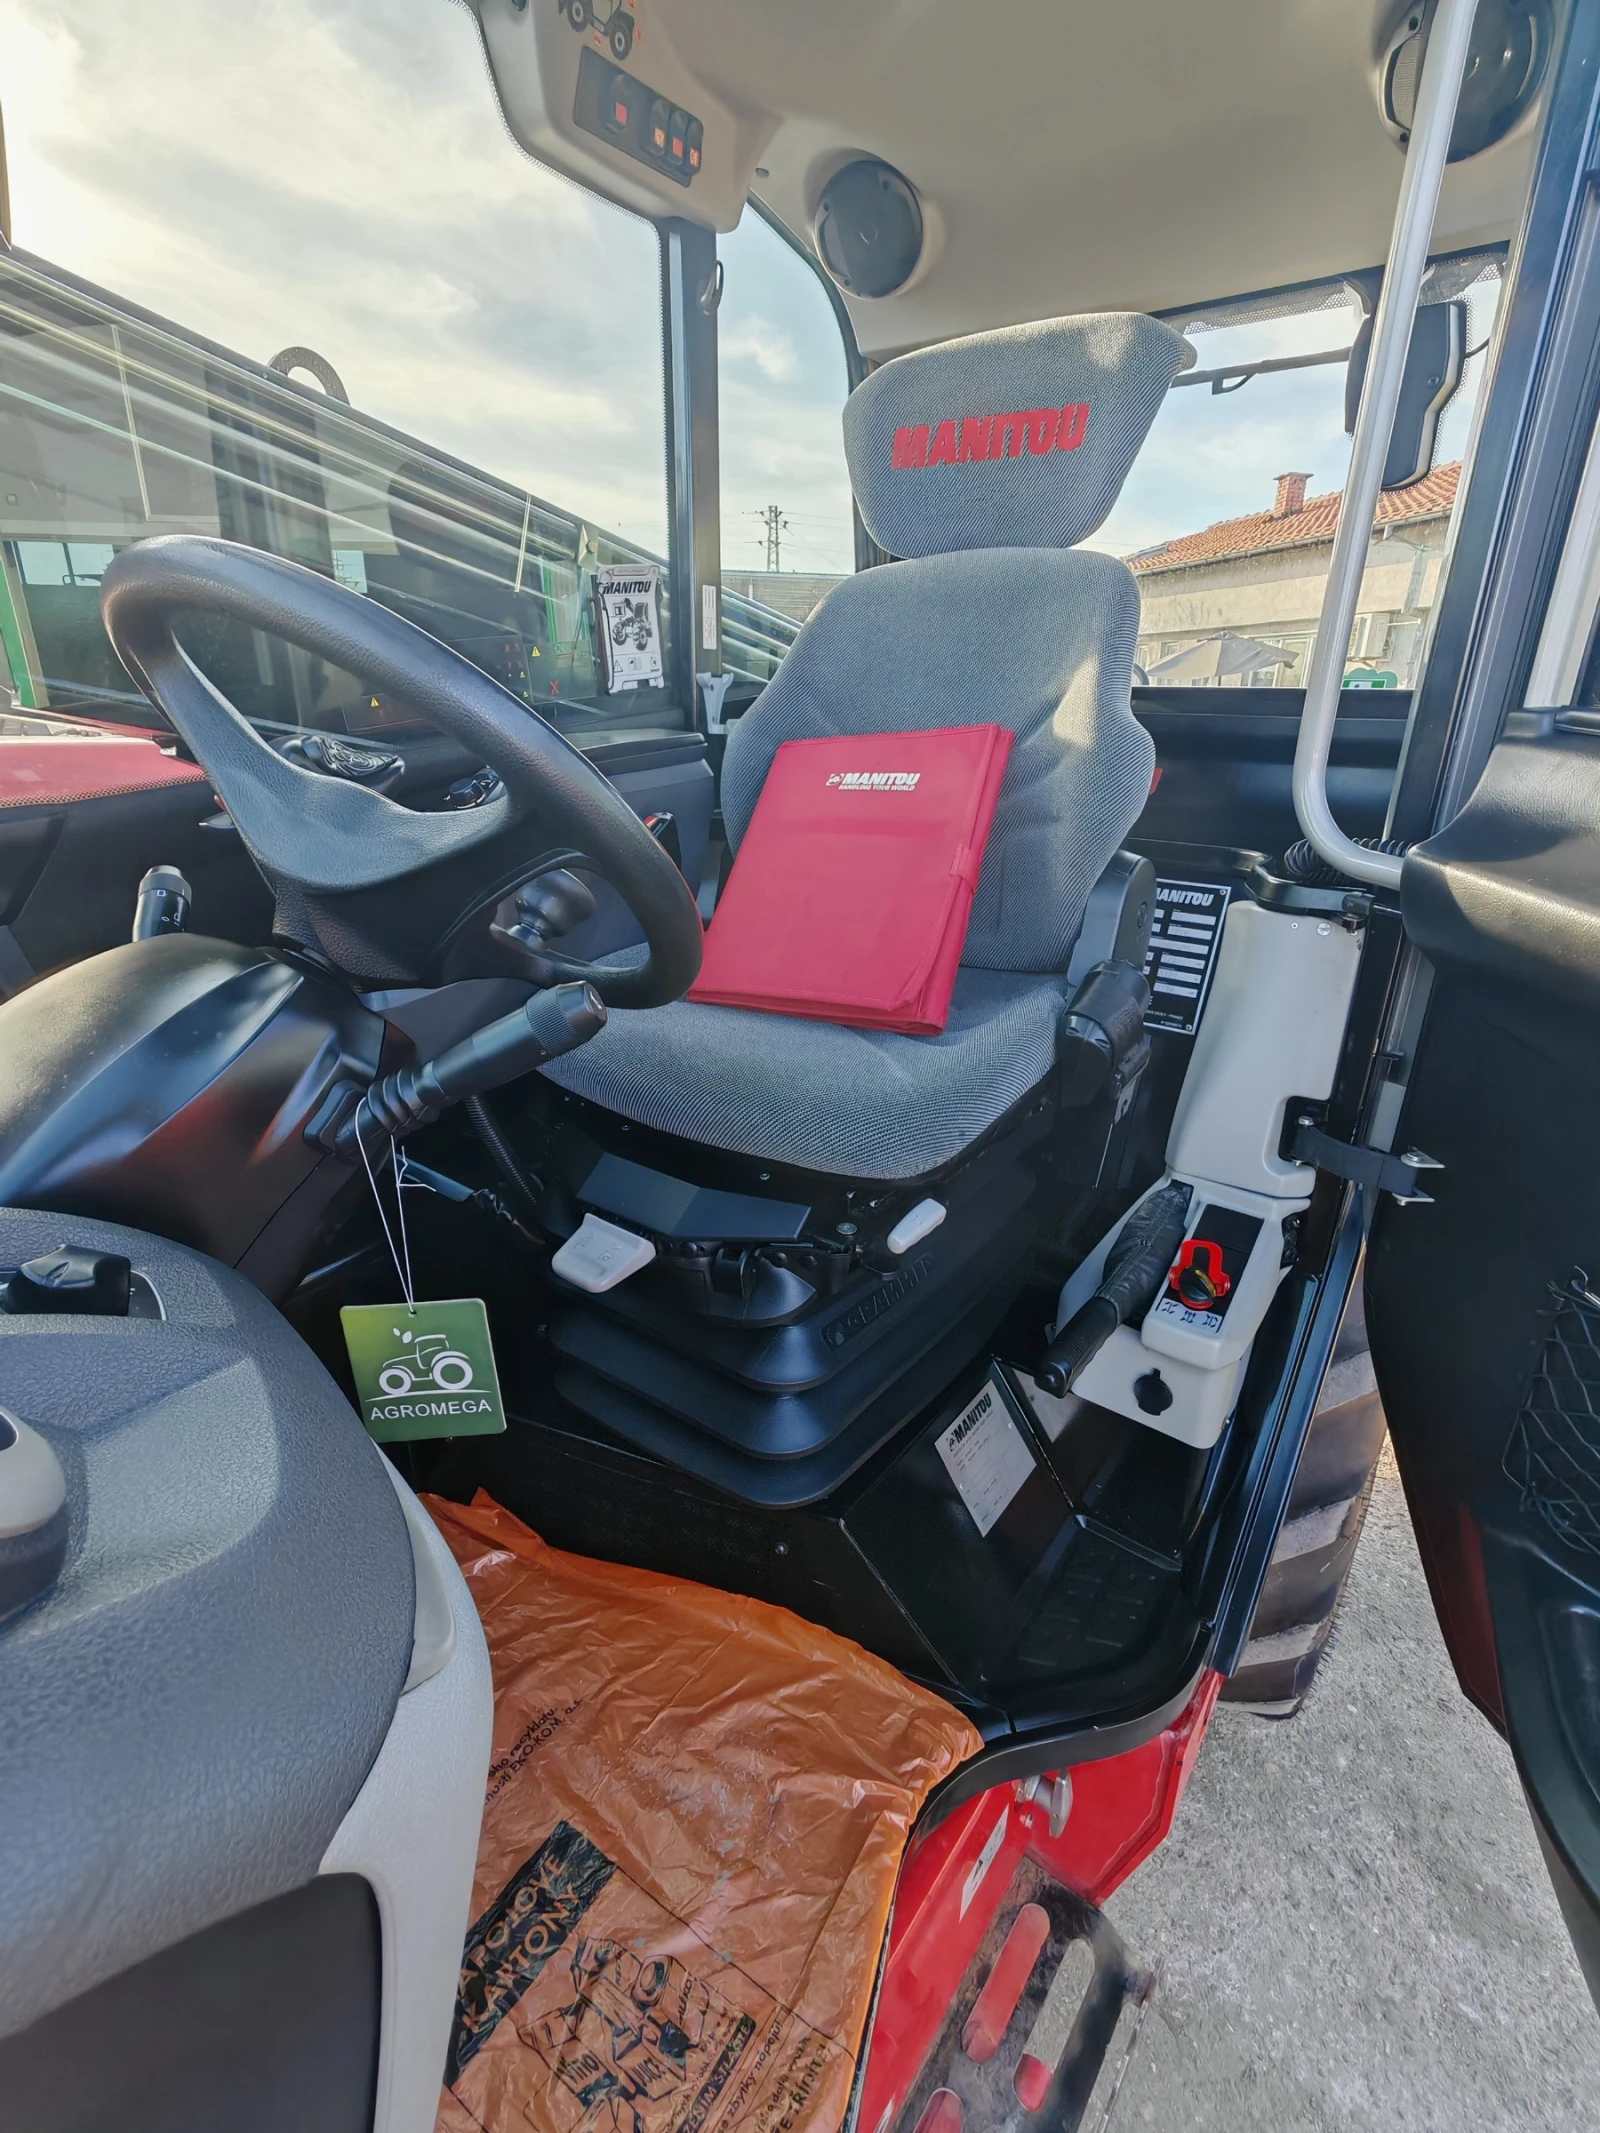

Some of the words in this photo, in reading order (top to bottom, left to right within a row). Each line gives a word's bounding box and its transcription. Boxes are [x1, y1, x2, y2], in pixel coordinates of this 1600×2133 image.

[891, 402, 1091, 470] MANITOU
[603, 581, 652, 594] MANITOU
[842, 772, 921, 785] MANITOU
[370, 1399, 492, 1420] AGROMEGA
[954, 1392, 992, 1443] MANITOU
[460, 1883, 581, 2033] KARTONY
